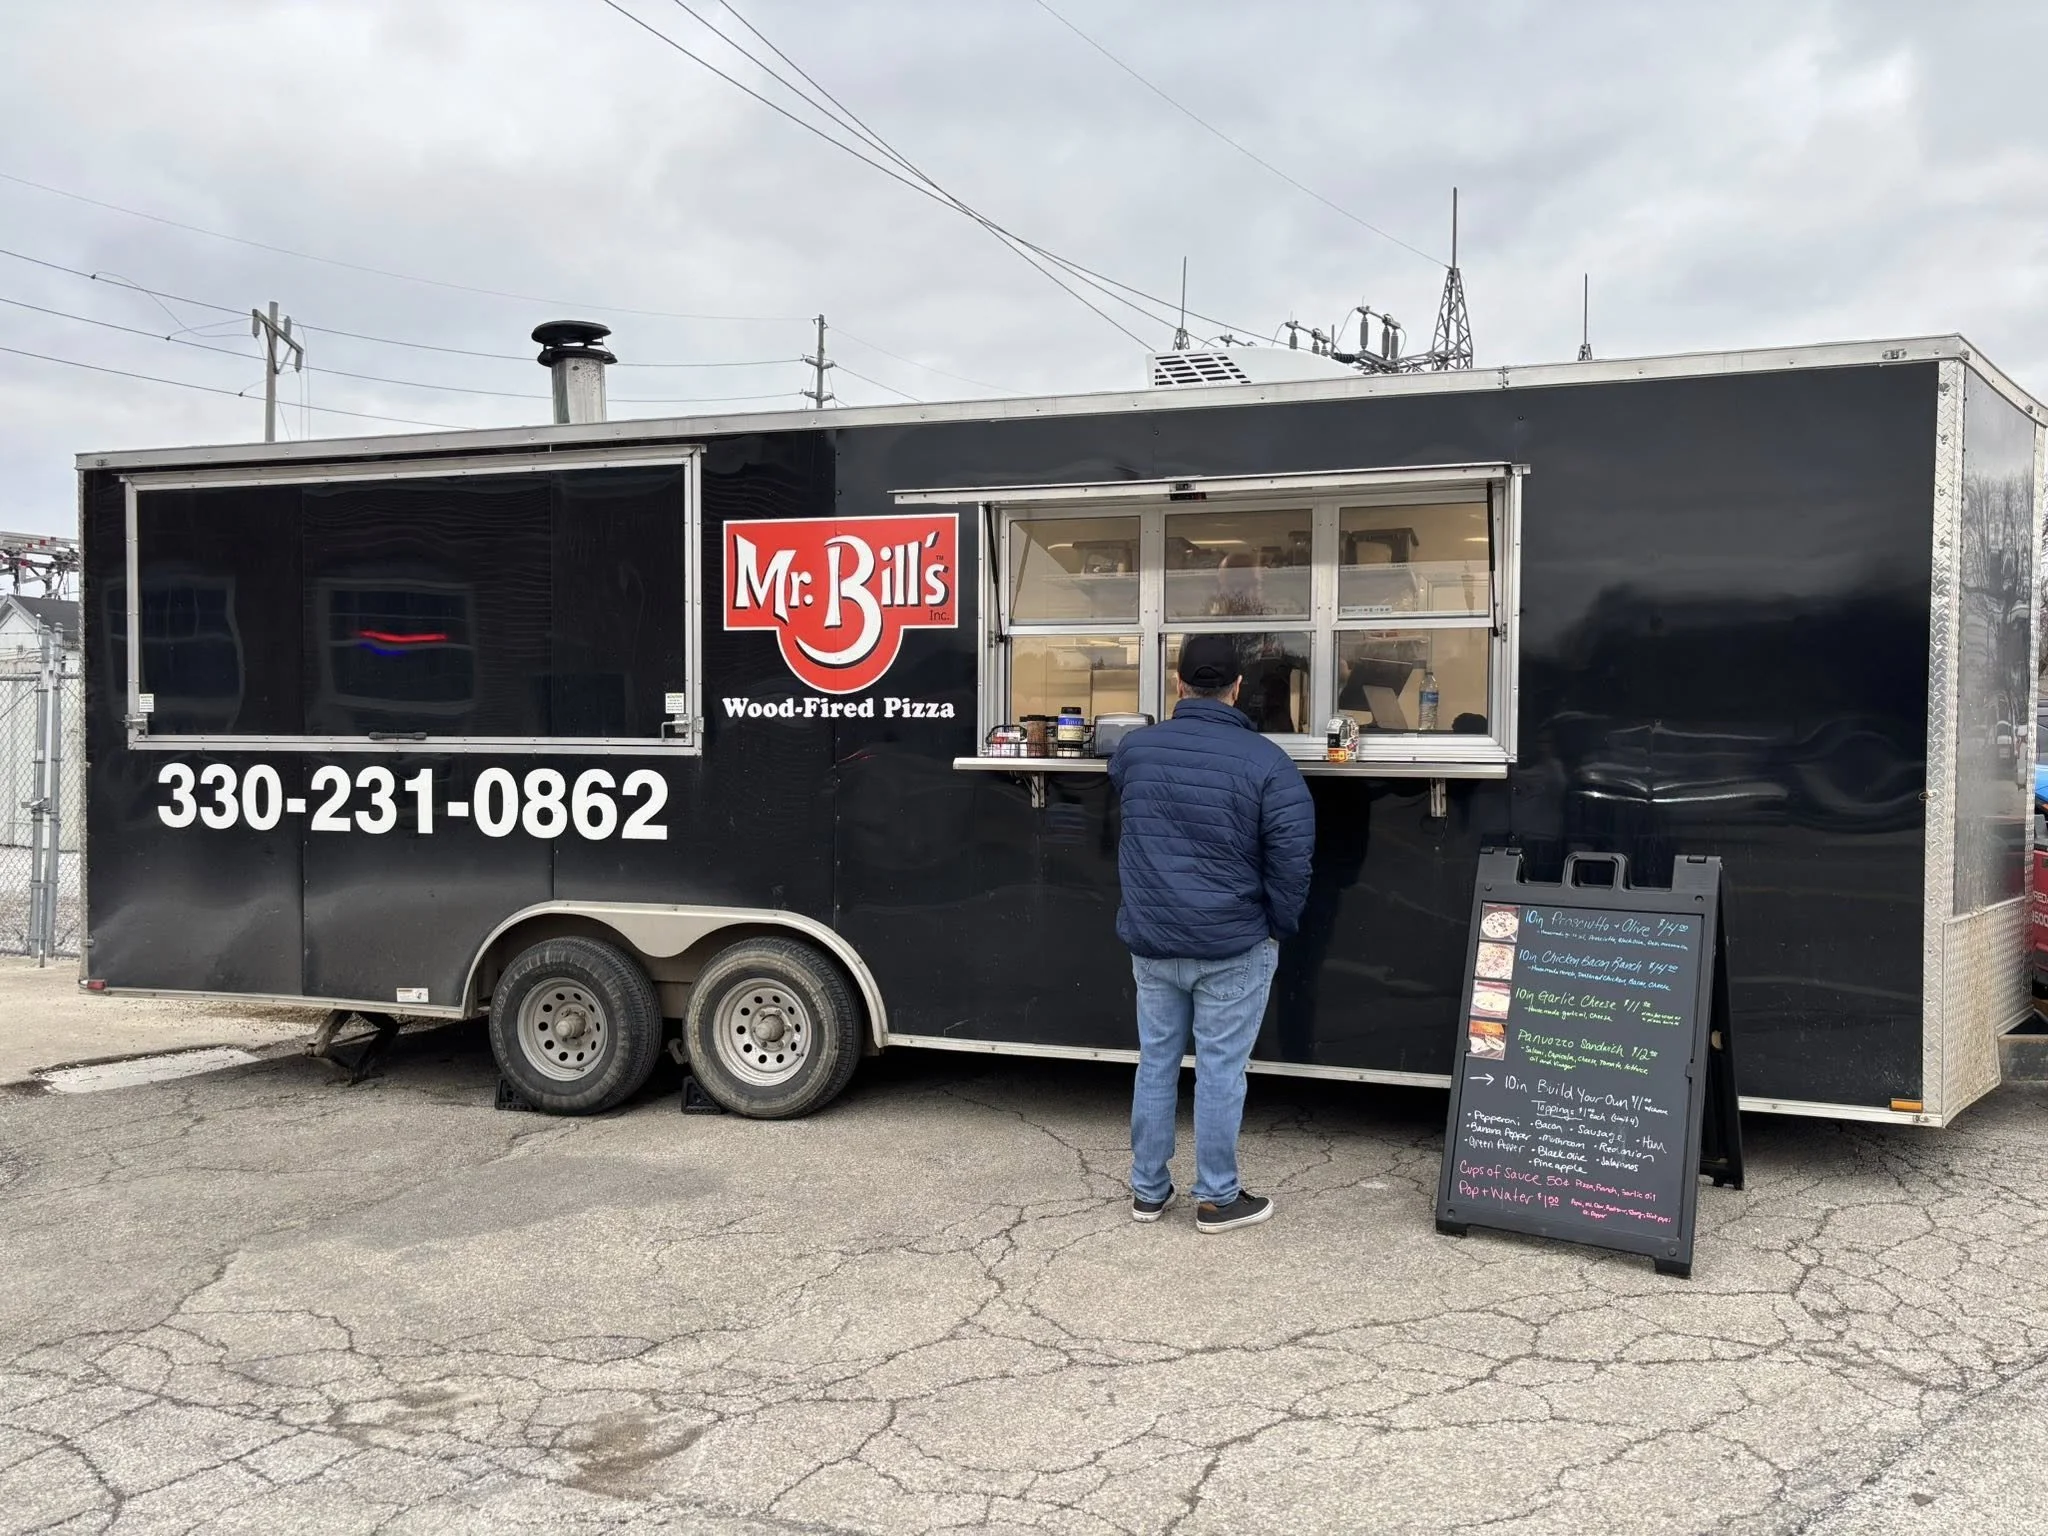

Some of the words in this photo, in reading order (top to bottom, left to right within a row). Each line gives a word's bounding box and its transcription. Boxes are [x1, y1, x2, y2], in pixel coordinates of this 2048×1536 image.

[732, 534, 814, 626] Mr.
[795, 531, 950, 669] Bill's
[929, 610, 950, 621] Inc.
[722, 697, 874, 718] Wood-Fired
[884, 697, 956, 718] Pizza
[157, 762, 669, 841] 330-231-0862
[1525, 910, 1544, 928] 10in
[1621, 918, 1651, 937] Olive
[1519, 948, 1538, 963] 10in
[1541, 949, 1580, 968] Chicken
[1580, 955, 1610, 972] Bacon
[1611, 956, 1643, 974] Ranch
[1515, 987, 1535, 1005] 10in
[1538, 990, 1576, 1006] Garlic
[1580, 994, 1617, 1011] Cheese
[1580, 1038, 1625, 1058] Sandwich
[1504, 1075, 1528, 1094] 10in
[1536, 1078, 1574, 1101] Build
[1576, 1086, 1604, 1104] Your
[1604, 1094, 1629, 1111] Own
[1470, 1121, 1502, 1137] Banana
[1503, 1127, 1532, 1141] Pepper
[1474, 1109, 1521, 1127] Pepperoni
[1534, 1119, 1563, 1134] Bacon
[1577, 1124, 1626, 1144] Sausage
[1642, 1134, 1668, 1155] Ham
[1468, 1136, 1494, 1149] Green
[1496, 1138, 1526, 1154] Pepper
[1537, 1145, 1566, 1159] Black
[1460, 1159, 1485, 1179] Cups
[1486, 1164, 1502, 1180] of
[1503, 1167, 1543, 1186] Sauce
